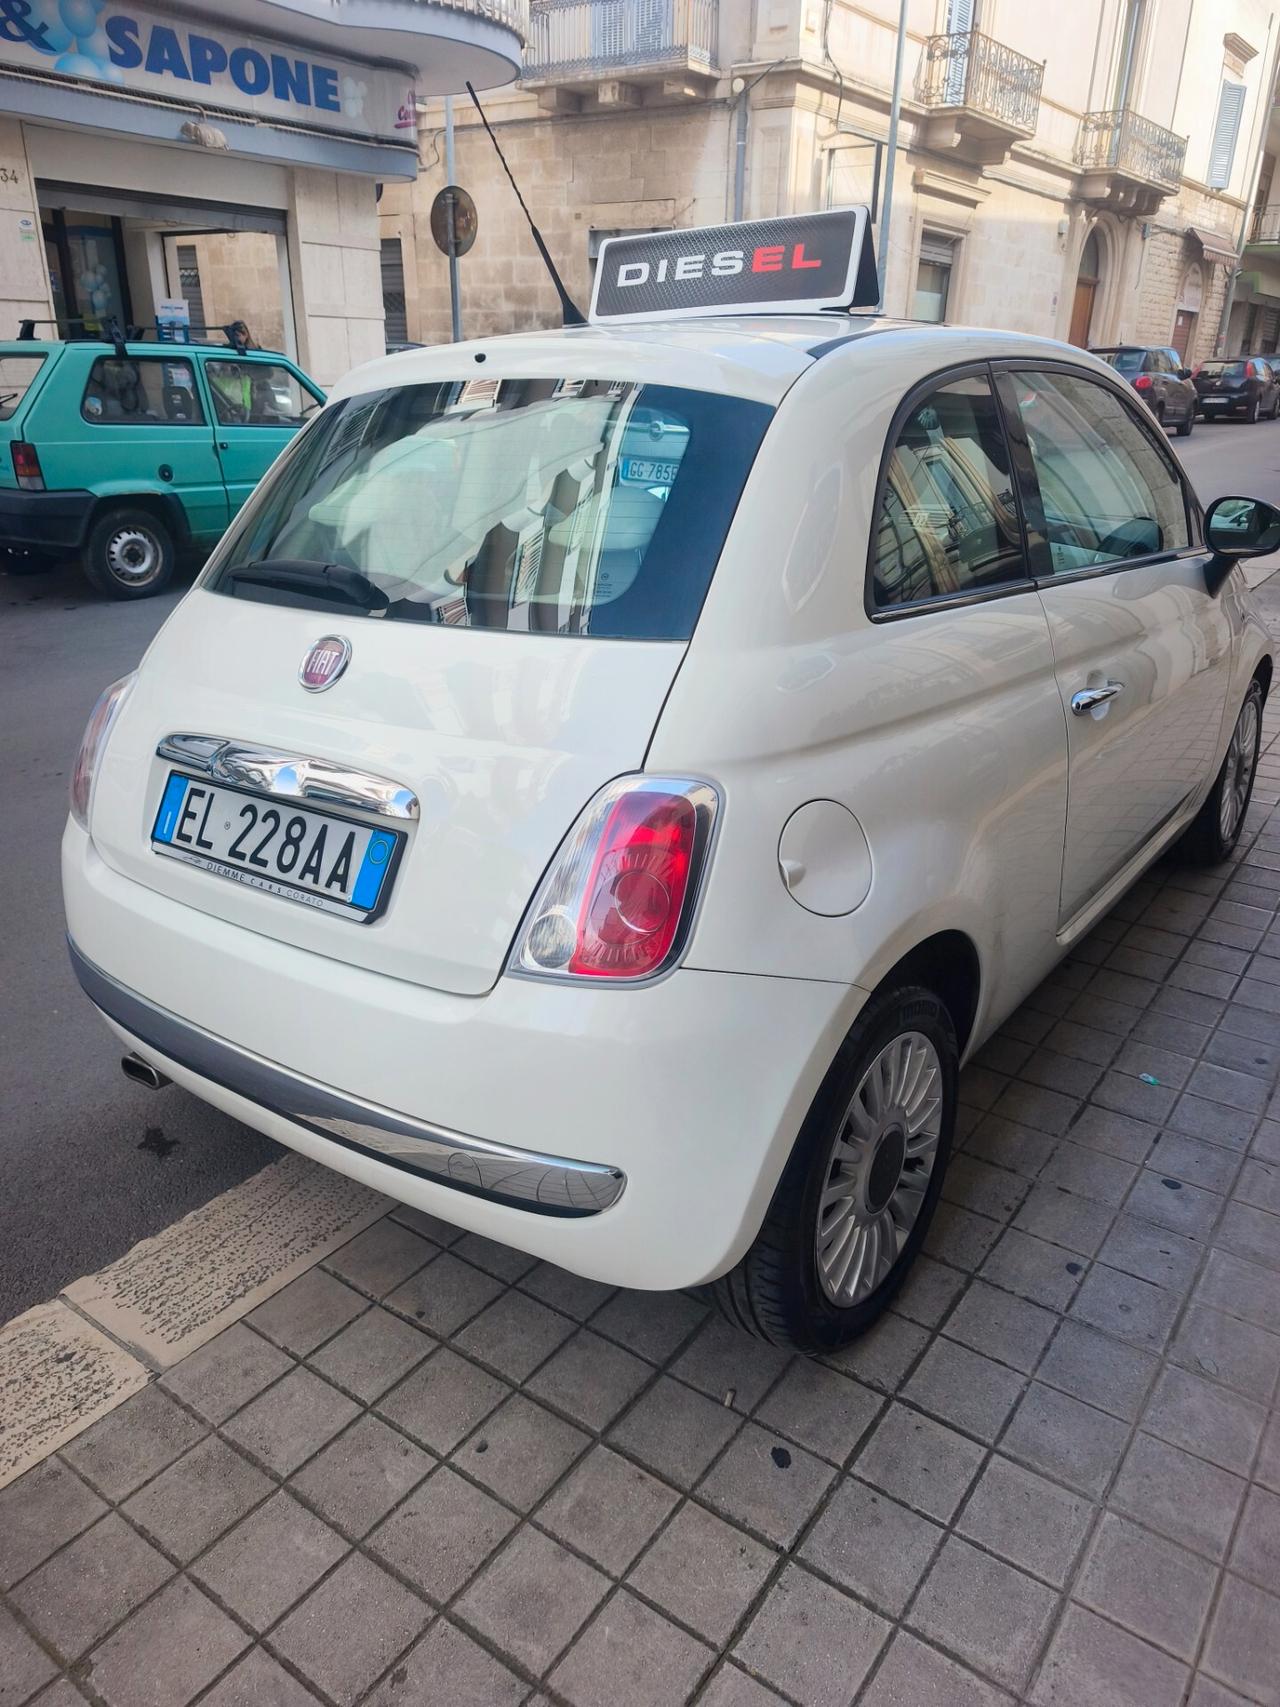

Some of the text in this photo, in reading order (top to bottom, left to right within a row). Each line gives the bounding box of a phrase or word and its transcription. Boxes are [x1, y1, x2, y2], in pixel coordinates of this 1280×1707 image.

[0, 0, 341, 113] & SAPONE
[616, 243, 823, 288] DIESEL
[306, 648, 340, 676] FIAT
[176, 786, 216, 851] EL
[228, 803, 355, 893] 228AA
[206, 861, 246, 883] DIEMME
